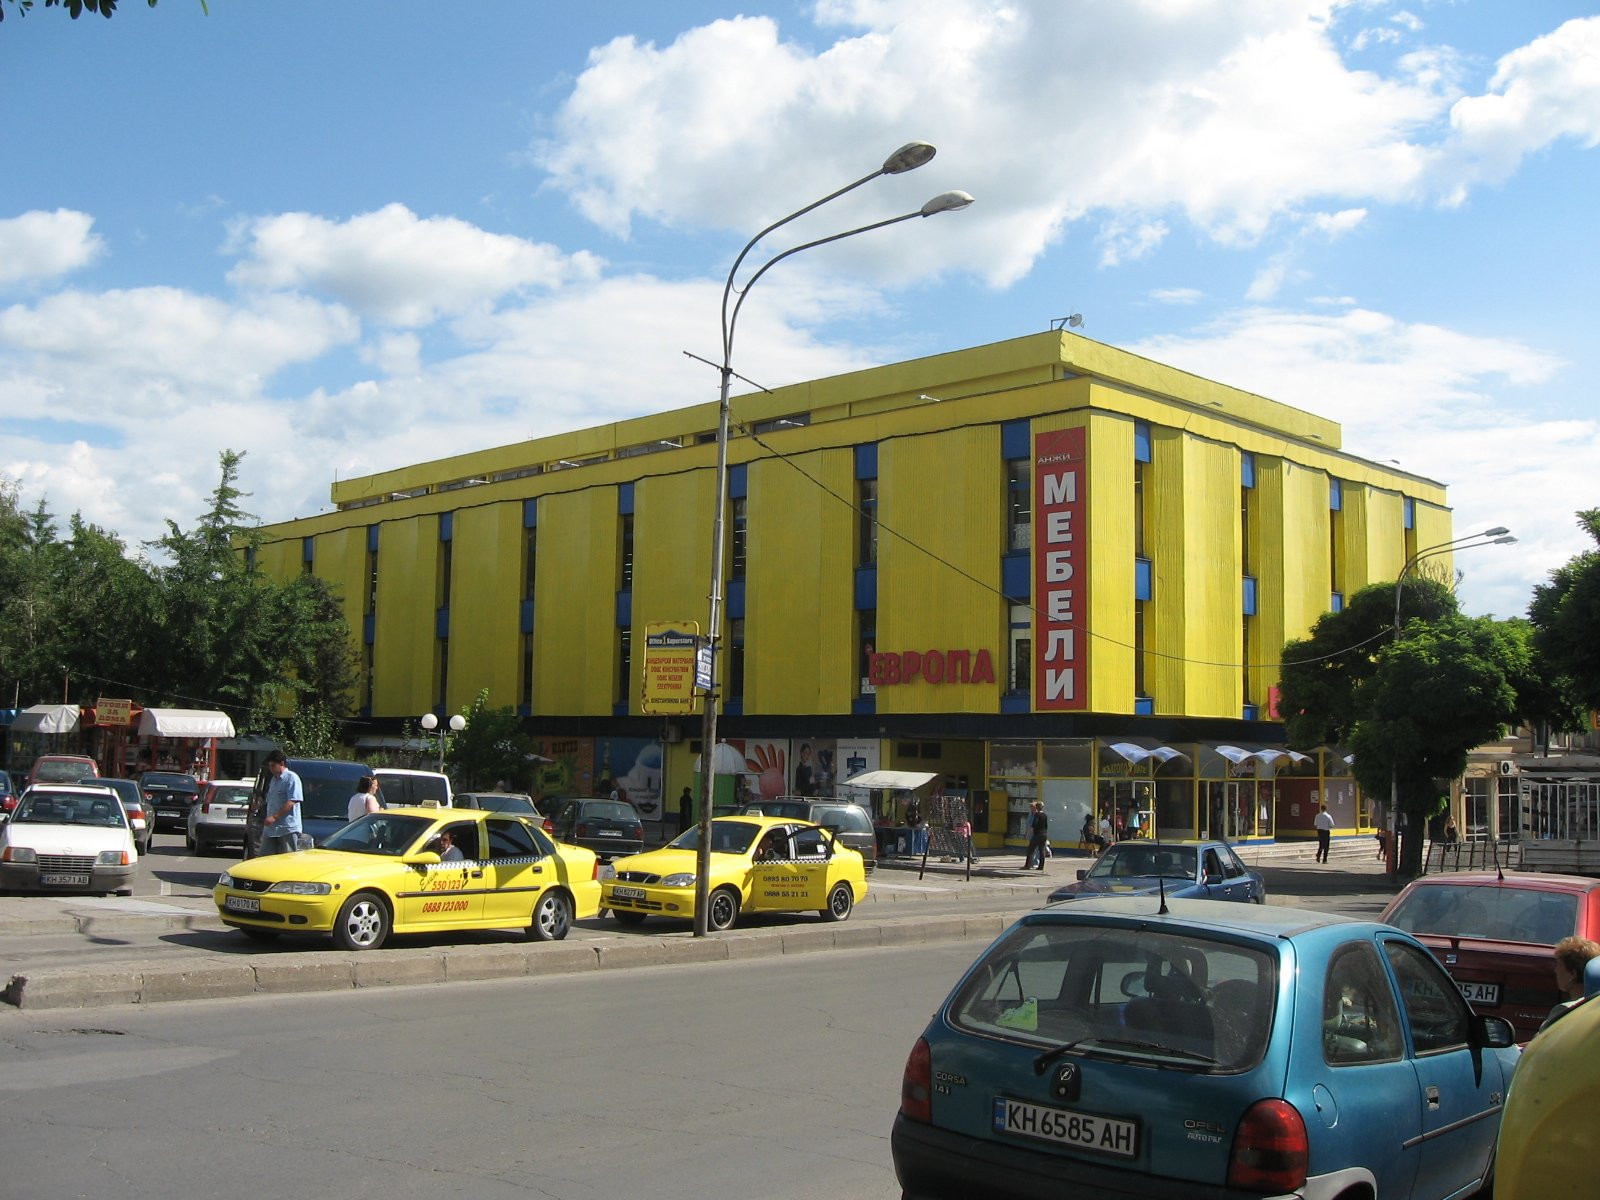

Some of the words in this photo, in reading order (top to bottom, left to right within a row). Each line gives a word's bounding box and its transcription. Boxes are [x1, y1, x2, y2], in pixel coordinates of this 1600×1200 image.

[1037, 454, 1071, 464] АНЖИ
[1043, 470, 1077, 701] МЕБЕЛИ
[868, 649, 995, 686] ЕВРОПА
[432, 880, 447, 890] 550
[448, 879, 461, 889] 123
[422, 902, 441, 913] 0888
[441, 901, 455, 912] 123
[454, 900, 469, 911] 000
[1475, 985, 1496, 1001] AH
[935, 1071, 966, 1085] CORSA
[1007, 1104, 1037, 1133] KH
[1041, 1111, 1095, 1144] 6585
[1100, 1122, 1132, 1151] AH
[1184, 1119, 1226, 1133] OPEL
